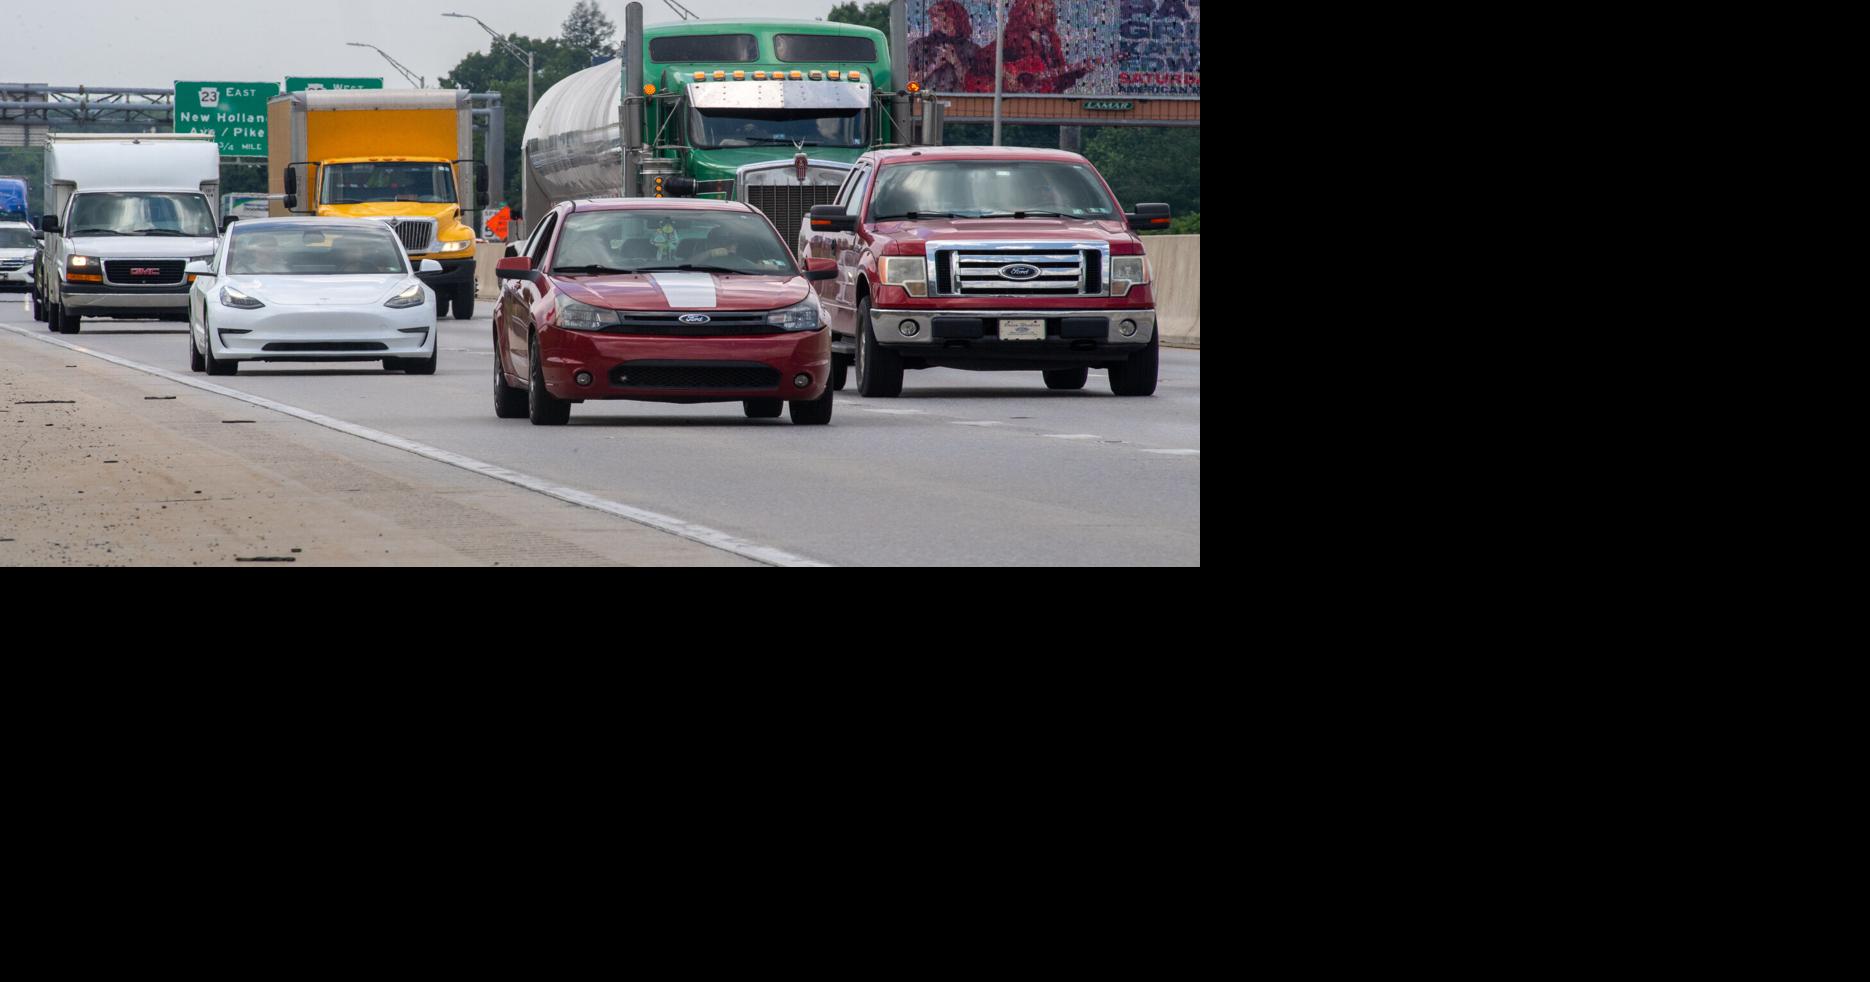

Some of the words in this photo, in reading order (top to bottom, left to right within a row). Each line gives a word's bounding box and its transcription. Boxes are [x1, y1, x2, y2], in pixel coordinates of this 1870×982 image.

[200, 91, 217, 102] 23
[1086, 101, 1130, 109] LAMAR
[180, 112, 210, 122] New
[216, 112, 267, 123] Hollan
[233, 127, 265, 138] Pike
[241, 143, 263, 151] MILE
[130, 267, 160, 276] GMC
